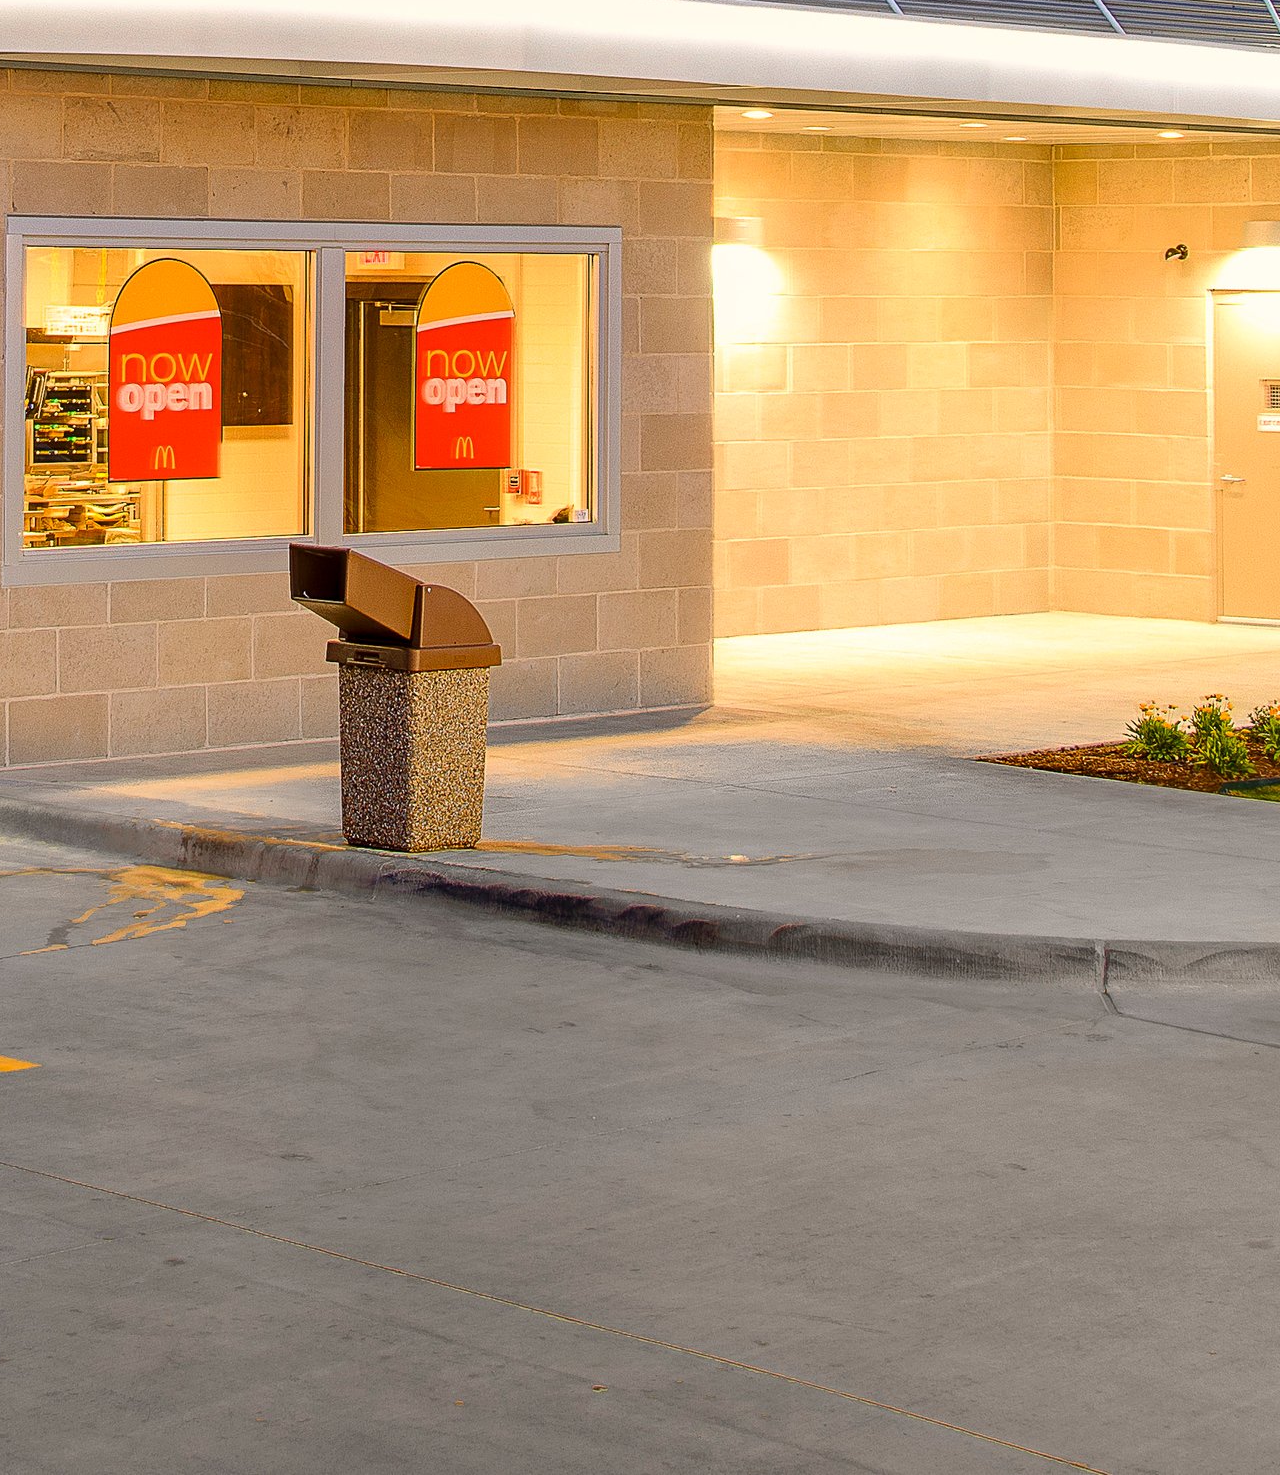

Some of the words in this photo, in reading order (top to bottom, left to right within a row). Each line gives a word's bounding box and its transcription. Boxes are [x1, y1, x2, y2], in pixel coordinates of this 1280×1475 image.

[121, 352, 213, 383] now
[427, 349, 508, 378] now
[116, 382, 213, 421] open
[421, 377, 507, 413] open
